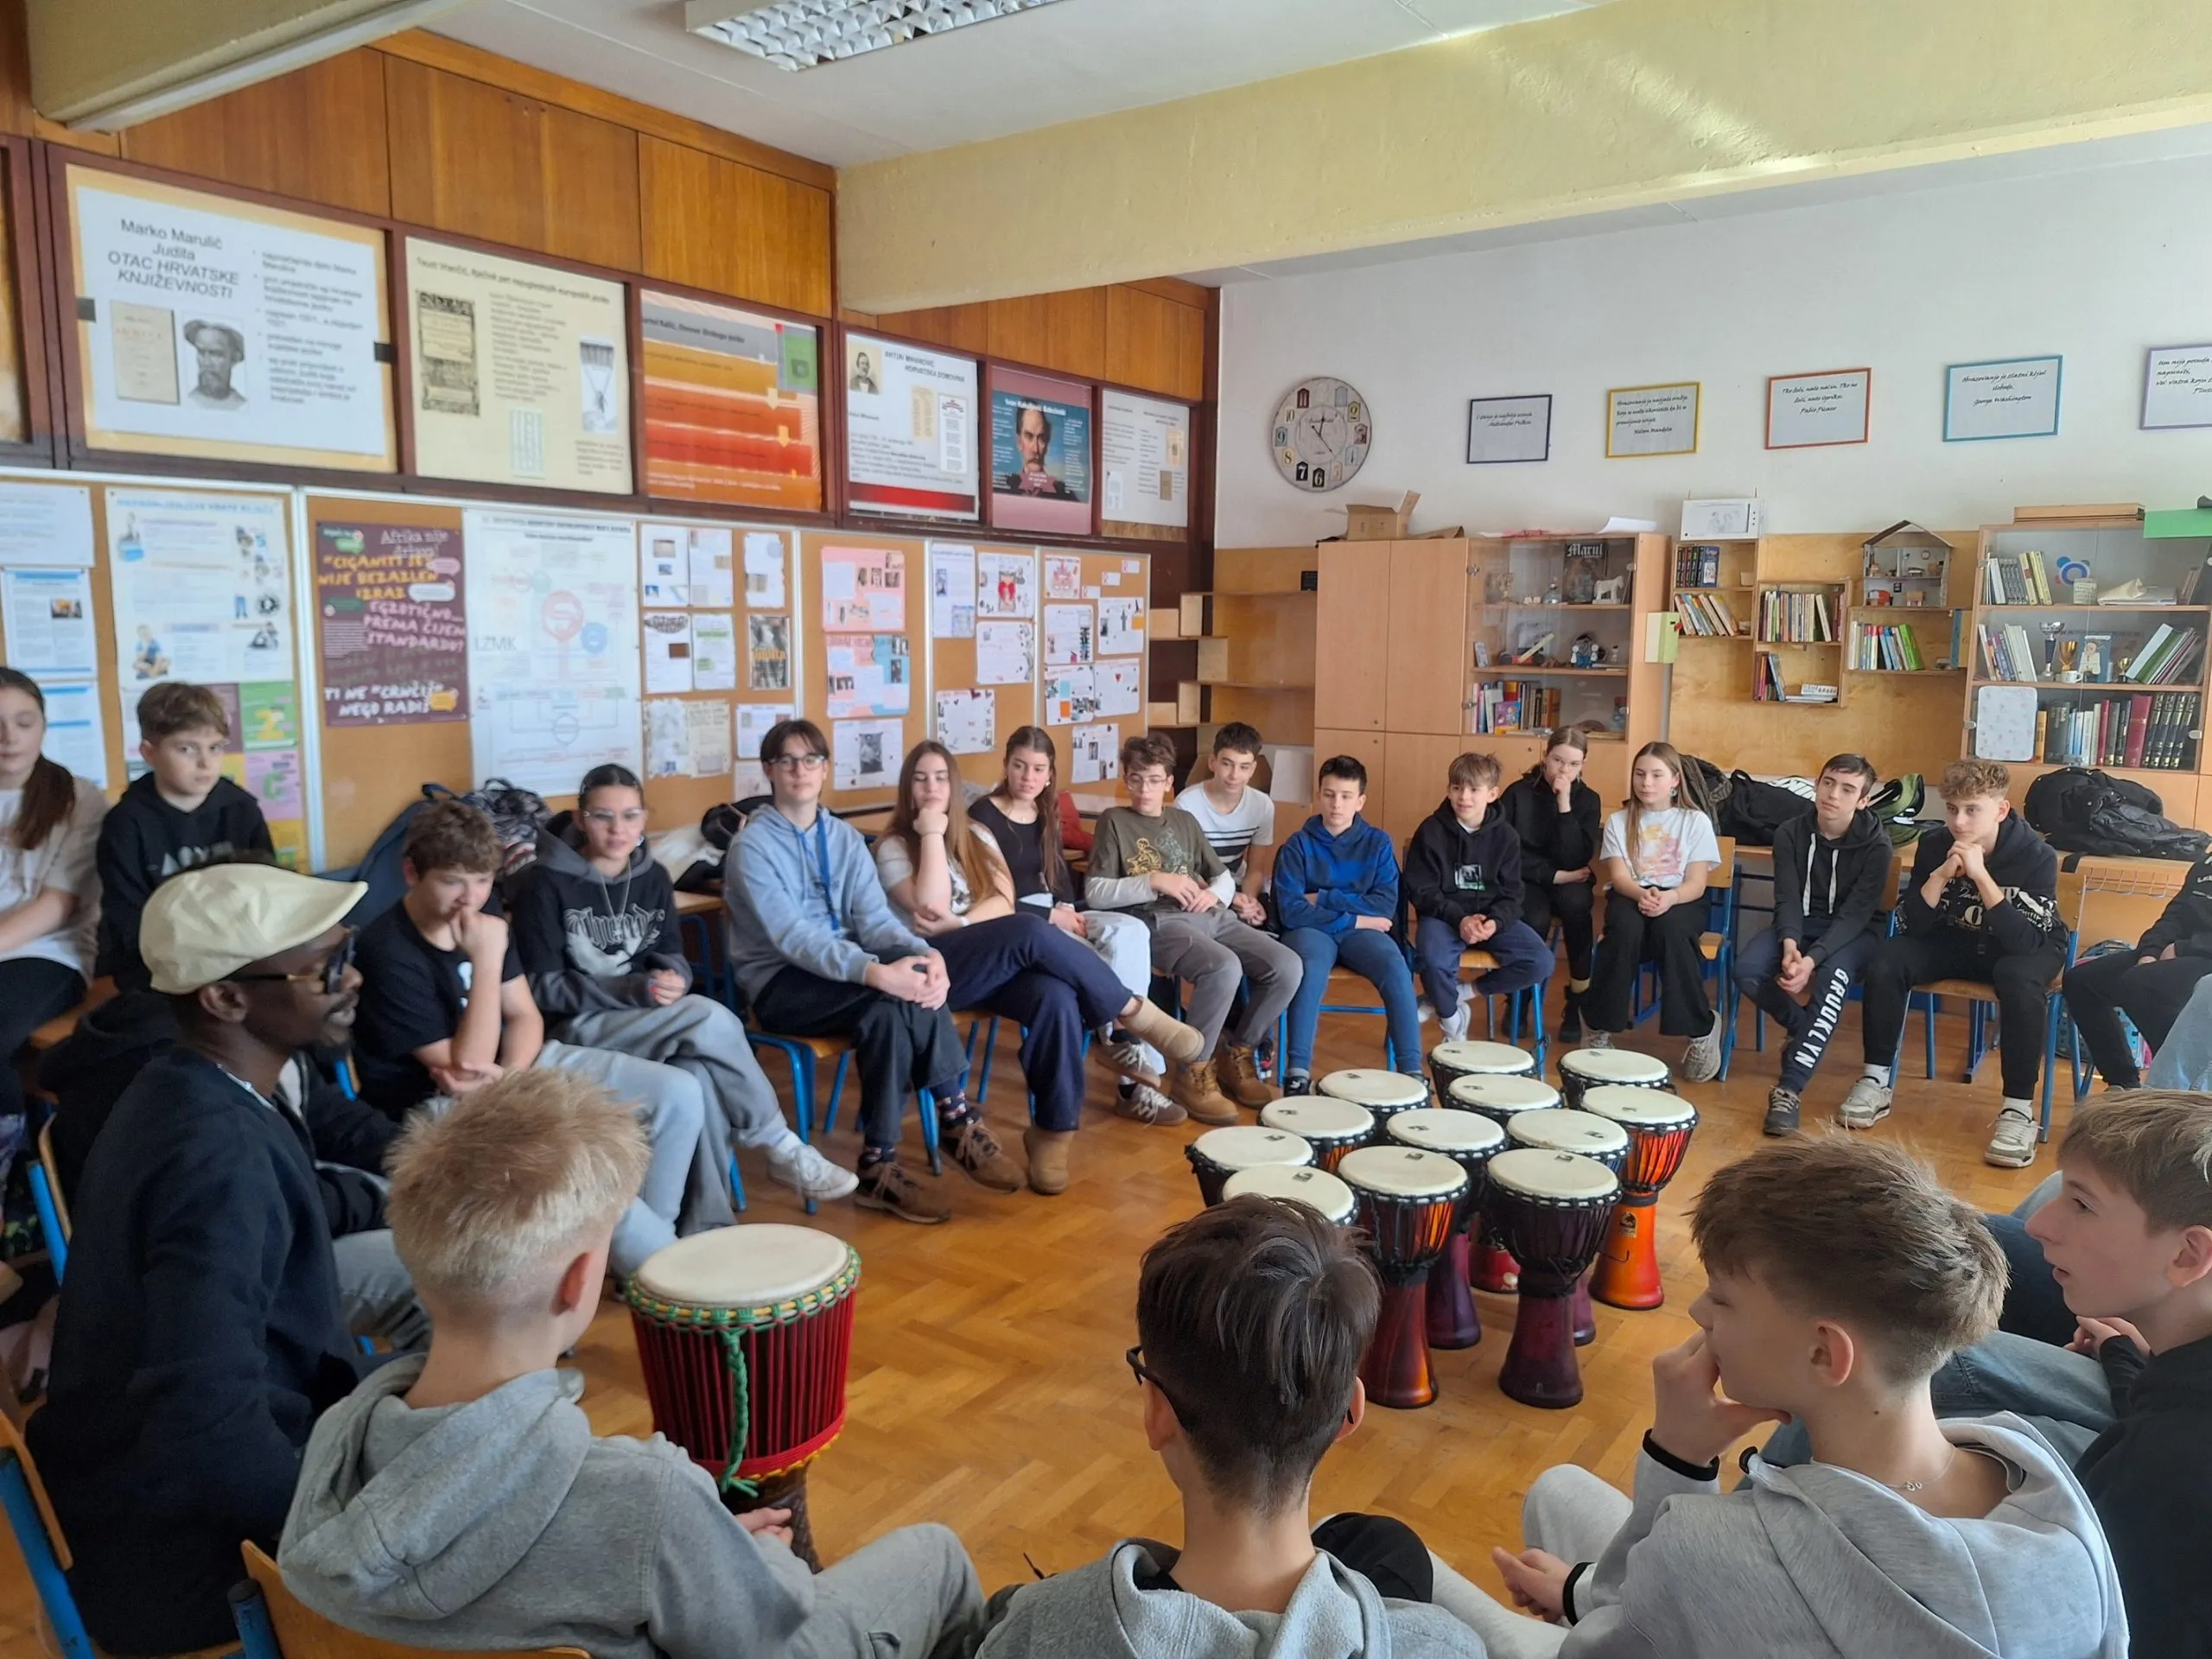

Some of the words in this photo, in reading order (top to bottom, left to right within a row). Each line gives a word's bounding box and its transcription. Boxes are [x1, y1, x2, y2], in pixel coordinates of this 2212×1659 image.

[120, 219, 168, 240] Marko
[171, 228, 223, 250] Marulić
[152, 243, 196, 262] Judita
[107, 250, 153, 270] OTAC
[156, 260, 240, 286] HRVATSKE
[118, 268, 233, 299] KNJIŽEVNOSTI
[1994, 395, 2032, 404] Washington
[1286, 409, 1295, 423] 10
[1277, 431, 1286, 446] 9
[1284, 451, 1292, 465] 8
[1298, 466, 1306, 480] 7
[1314, 472, 1323, 486] 6
[380, 529, 423, 544] Afrika
[1566, 543, 1604, 557] Marul
[317, 573, 352, 586] NIJE
[363, 613, 418, 633] PREMA
[323, 686, 340, 702] TI
[344, 685, 368, 701] NE
[338, 701, 380, 719] NEGO
[1794, 968, 1849, 1069] BROOKLYN
